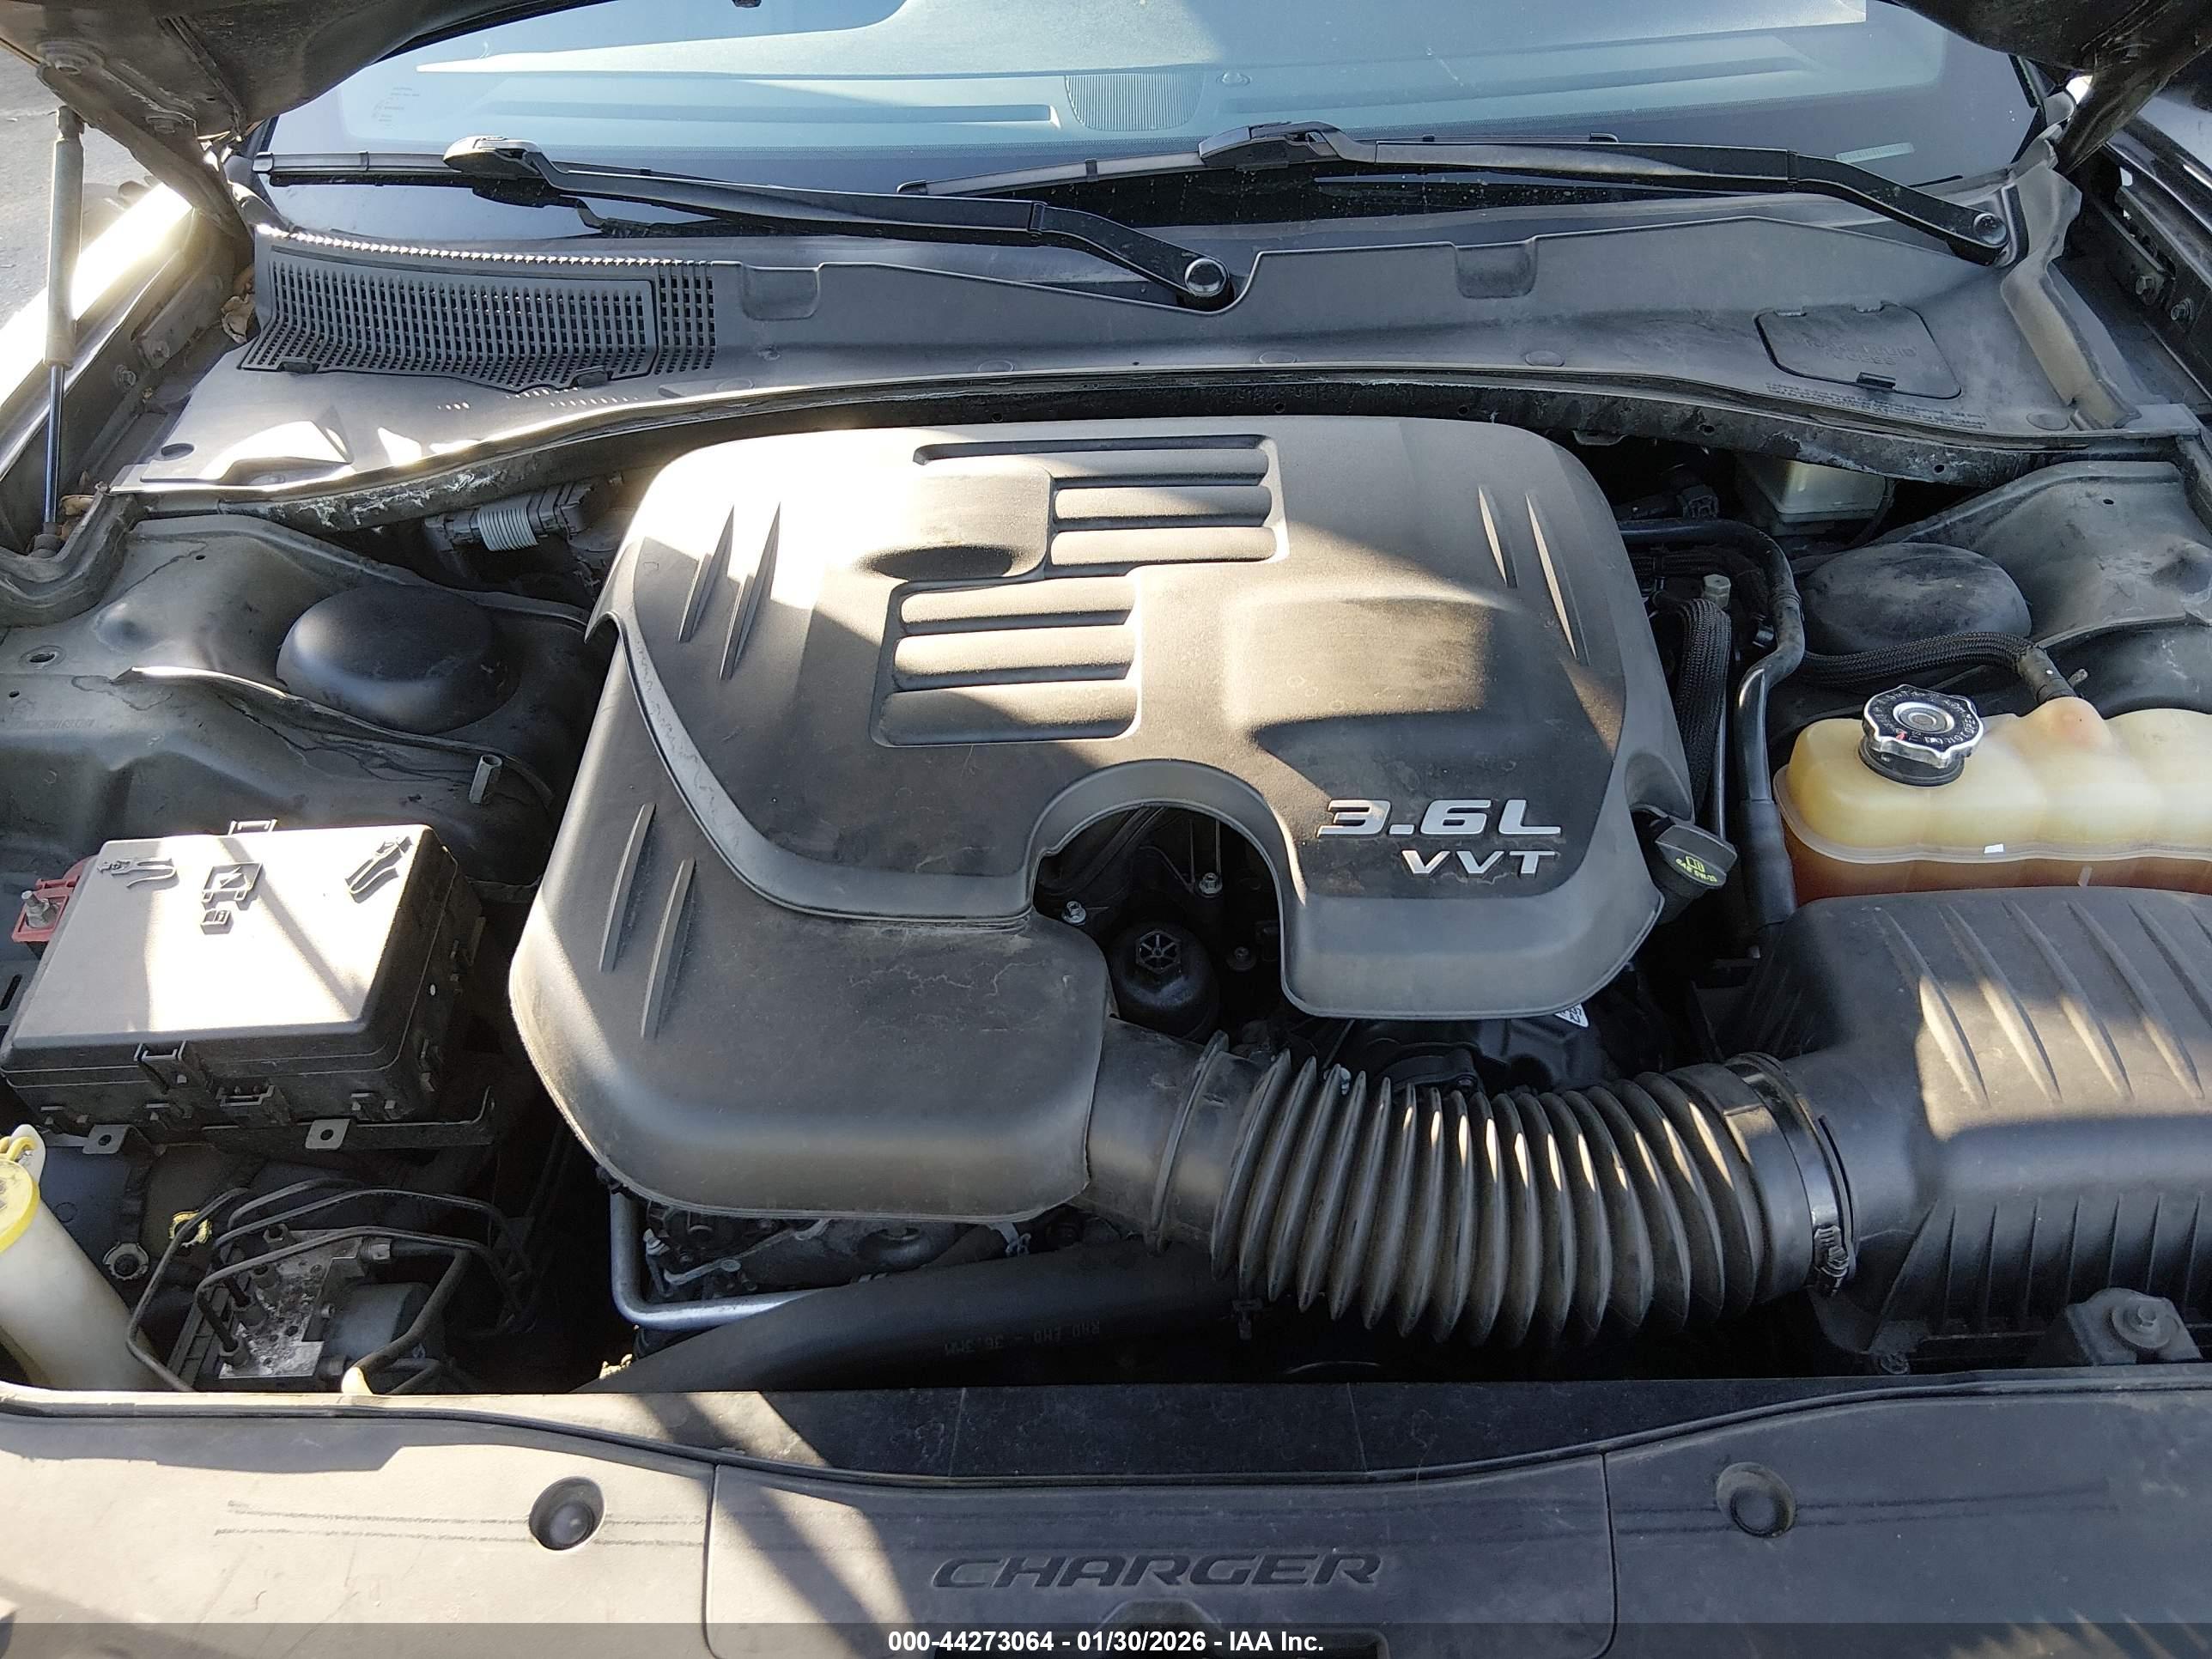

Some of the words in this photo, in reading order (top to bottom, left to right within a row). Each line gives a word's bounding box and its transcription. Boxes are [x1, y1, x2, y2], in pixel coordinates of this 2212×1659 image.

[1316, 799, 1562, 837] 3.6L
[1401, 850, 1556, 877] VVT
[1675, 858, 1692, 873] SAE
[933, 1552, 1382, 1589] CHARGER
